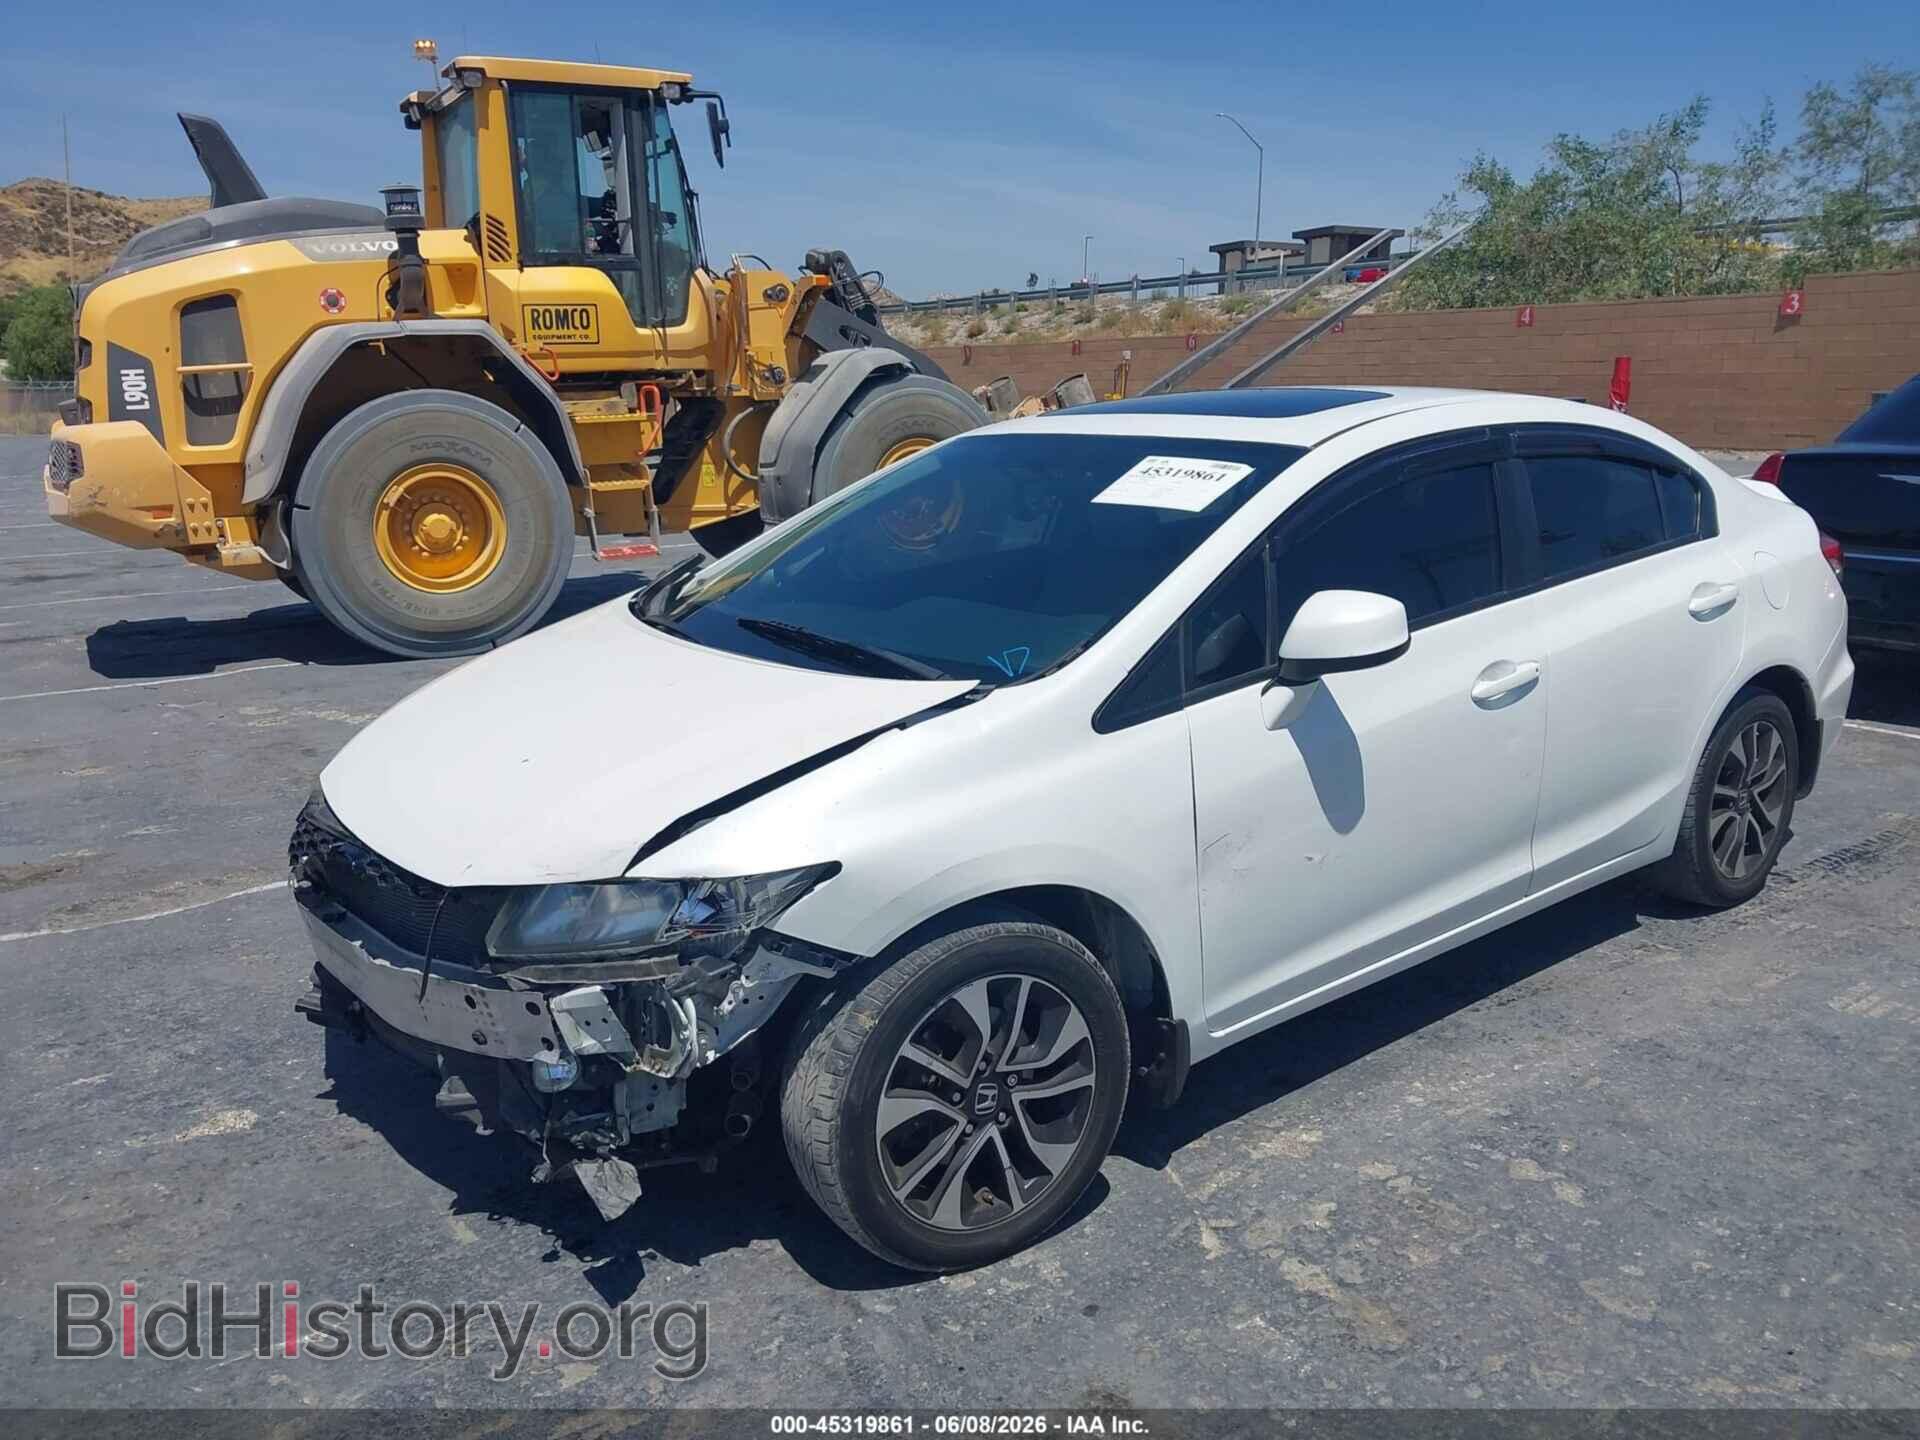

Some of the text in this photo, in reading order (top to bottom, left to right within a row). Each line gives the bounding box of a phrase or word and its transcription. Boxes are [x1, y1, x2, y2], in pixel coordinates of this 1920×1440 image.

[311, 240, 400, 254] VOLVO
[1785, 293, 1800, 313] 3
[530, 307, 591, 331] ROMCO
[1520, 306, 1530, 324] 4
[119, 368, 151, 411] L90H
[1139, 466, 1227, 482] 45319861
